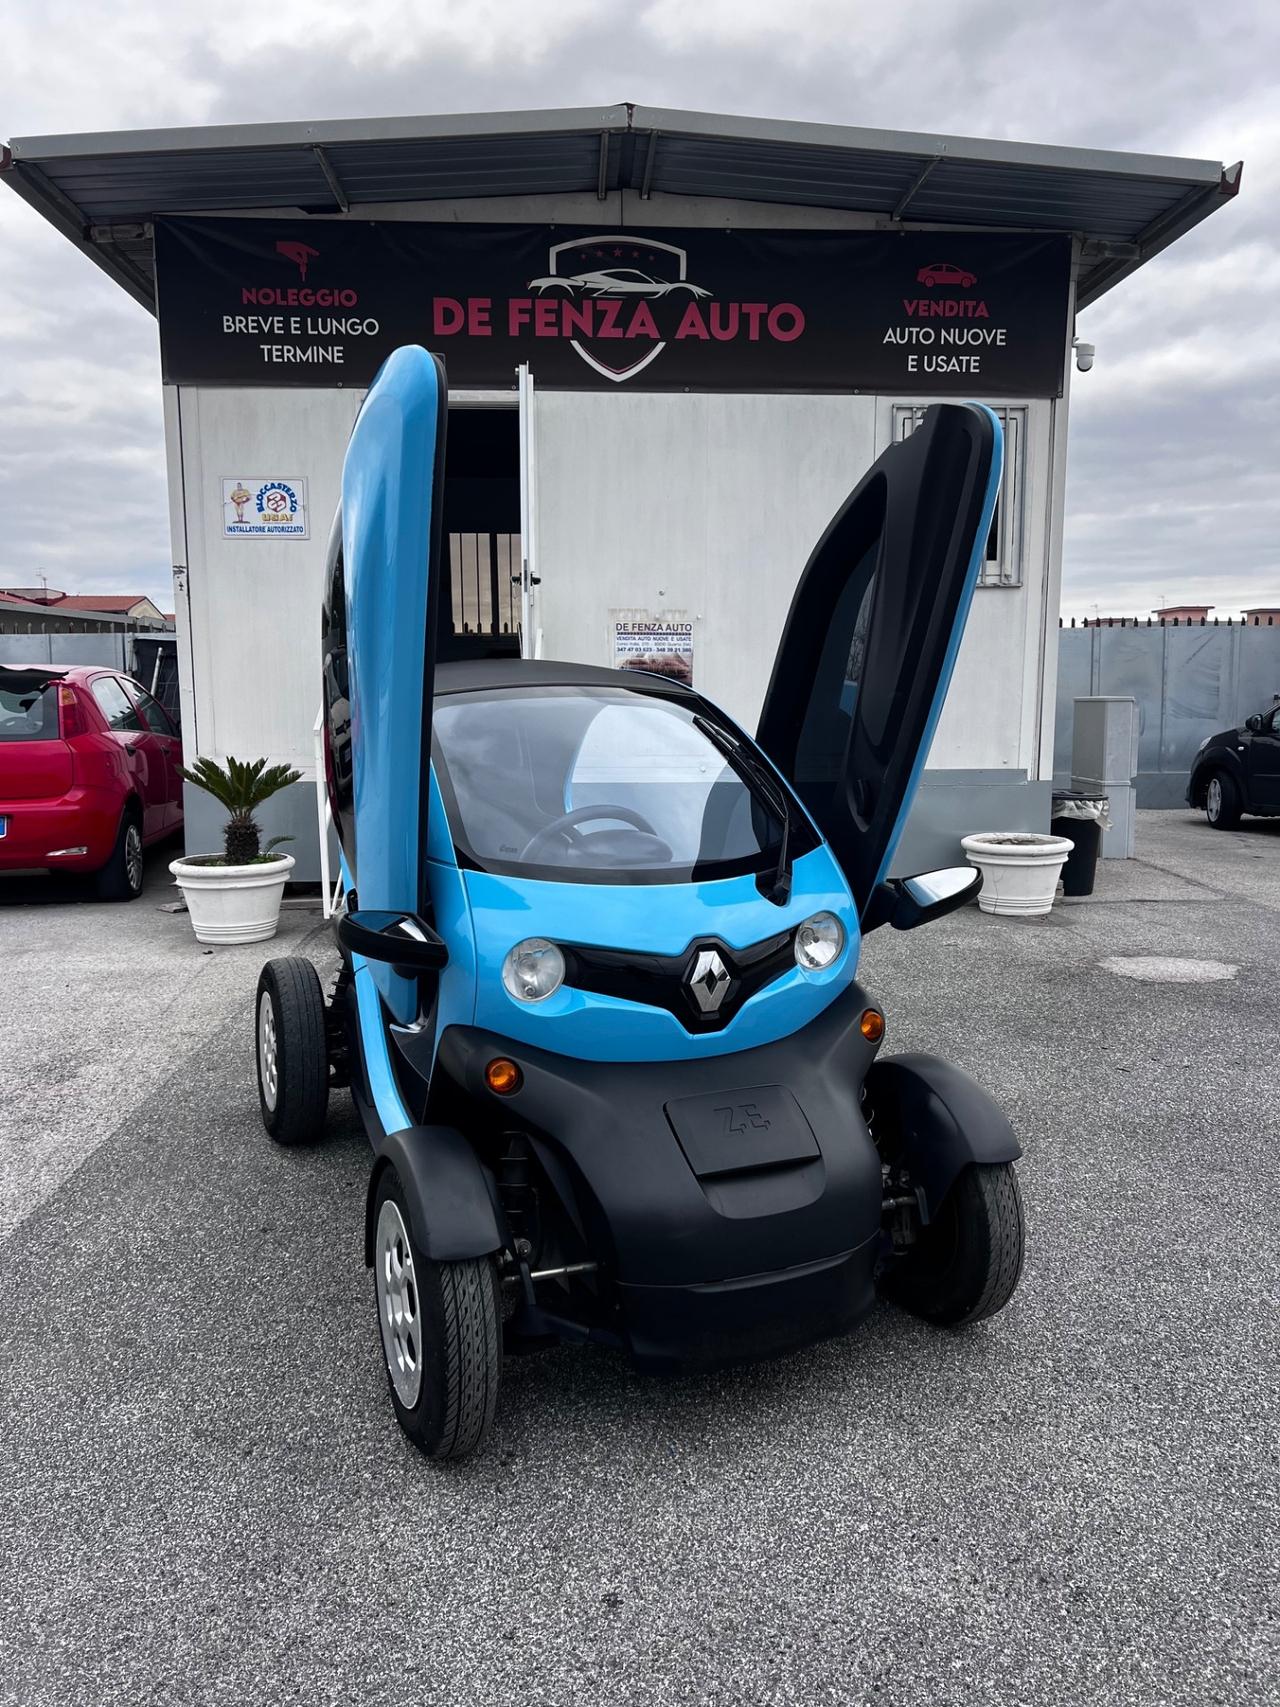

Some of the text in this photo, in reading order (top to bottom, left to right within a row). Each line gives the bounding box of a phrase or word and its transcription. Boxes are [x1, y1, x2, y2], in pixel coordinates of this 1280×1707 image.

[241, 288, 358, 307] NOLEGGIO
[903, 299, 990, 318] VENDITA
[222, 315, 380, 336] BREVE E LUNGO
[432, 297, 806, 342] DE FENZA AUTO
[882, 327, 1008, 346] AUTO NUOVE
[259, 345, 344, 363] TERMINE
[907, 355, 981, 373] E USATE
[256, 482, 298, 513] BLOCCASTERZO
[226, 525, 304, 533] INSTALLATORE AUTORIZZATO
[616, 623, 693, 632] DE FENZA AUTO
